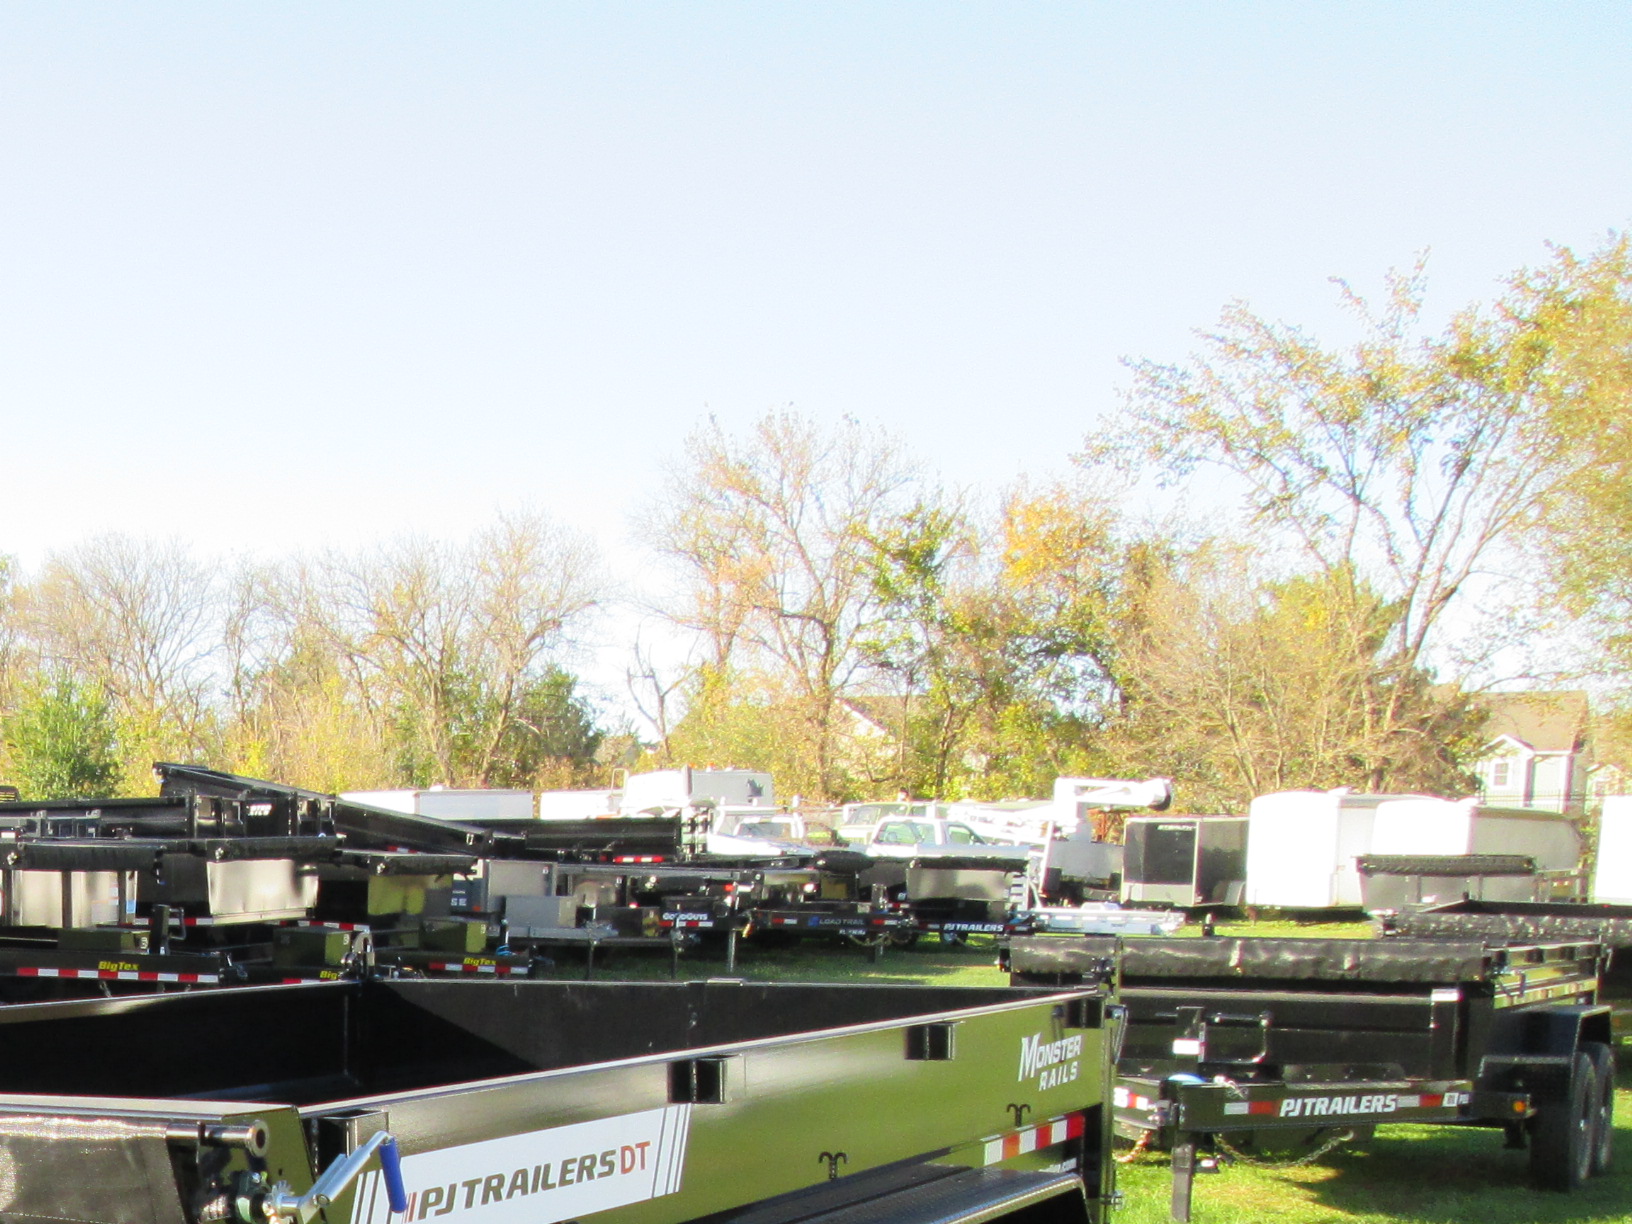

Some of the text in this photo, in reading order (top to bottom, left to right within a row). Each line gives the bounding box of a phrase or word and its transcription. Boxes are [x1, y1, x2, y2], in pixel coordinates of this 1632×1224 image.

[98, 961, 139, 972] BigTex
[1017, 1031, 1082, 1082] MONSTER
[1039, 1061, 1078, 1092] RAILS
[1303, 1093, 1399, 1117] TRAILERS
[460, 1148, 618, 1211] TRAILERS
[620, 1140, 651, 1176] DT
